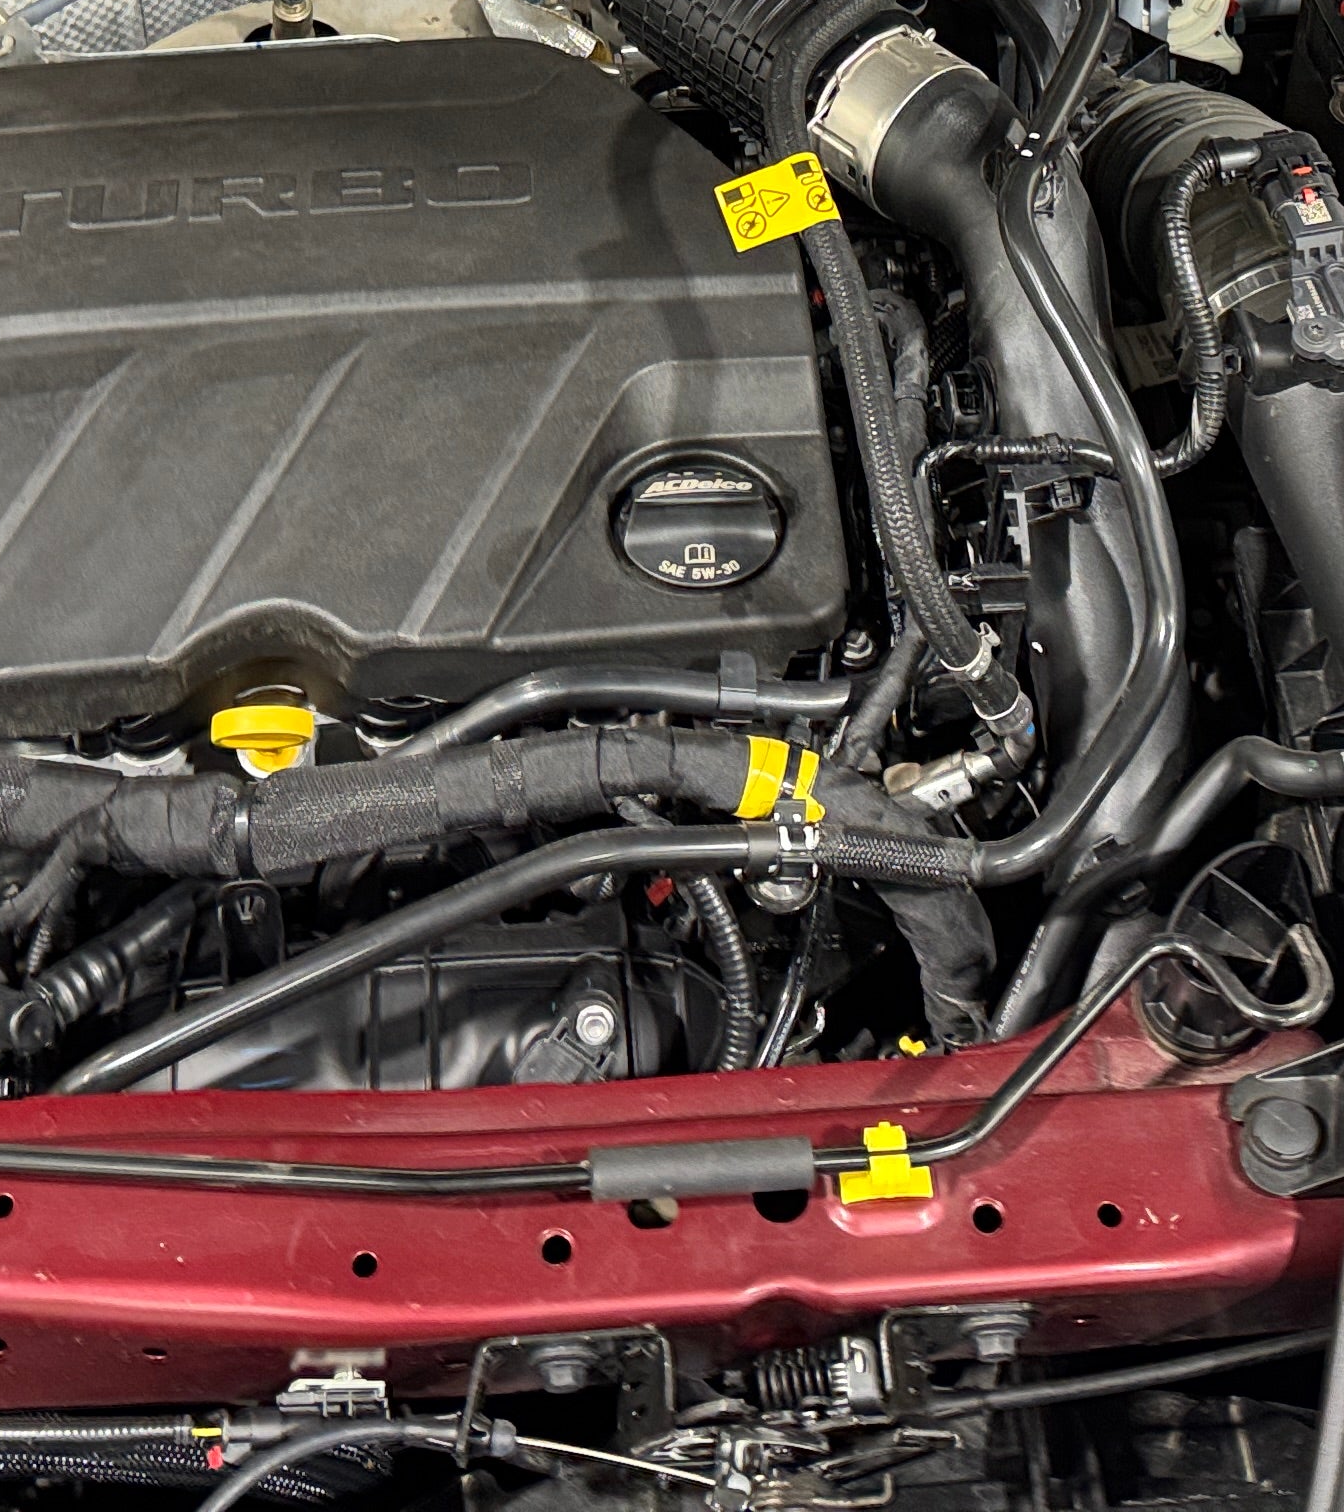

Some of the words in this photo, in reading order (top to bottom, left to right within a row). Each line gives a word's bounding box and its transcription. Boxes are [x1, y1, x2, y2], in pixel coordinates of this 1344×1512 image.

[643, 478, 753, 494] ACDelco
[658, 560, 687, 579] SAE
[691, 559, 741, 580] 5W-30
